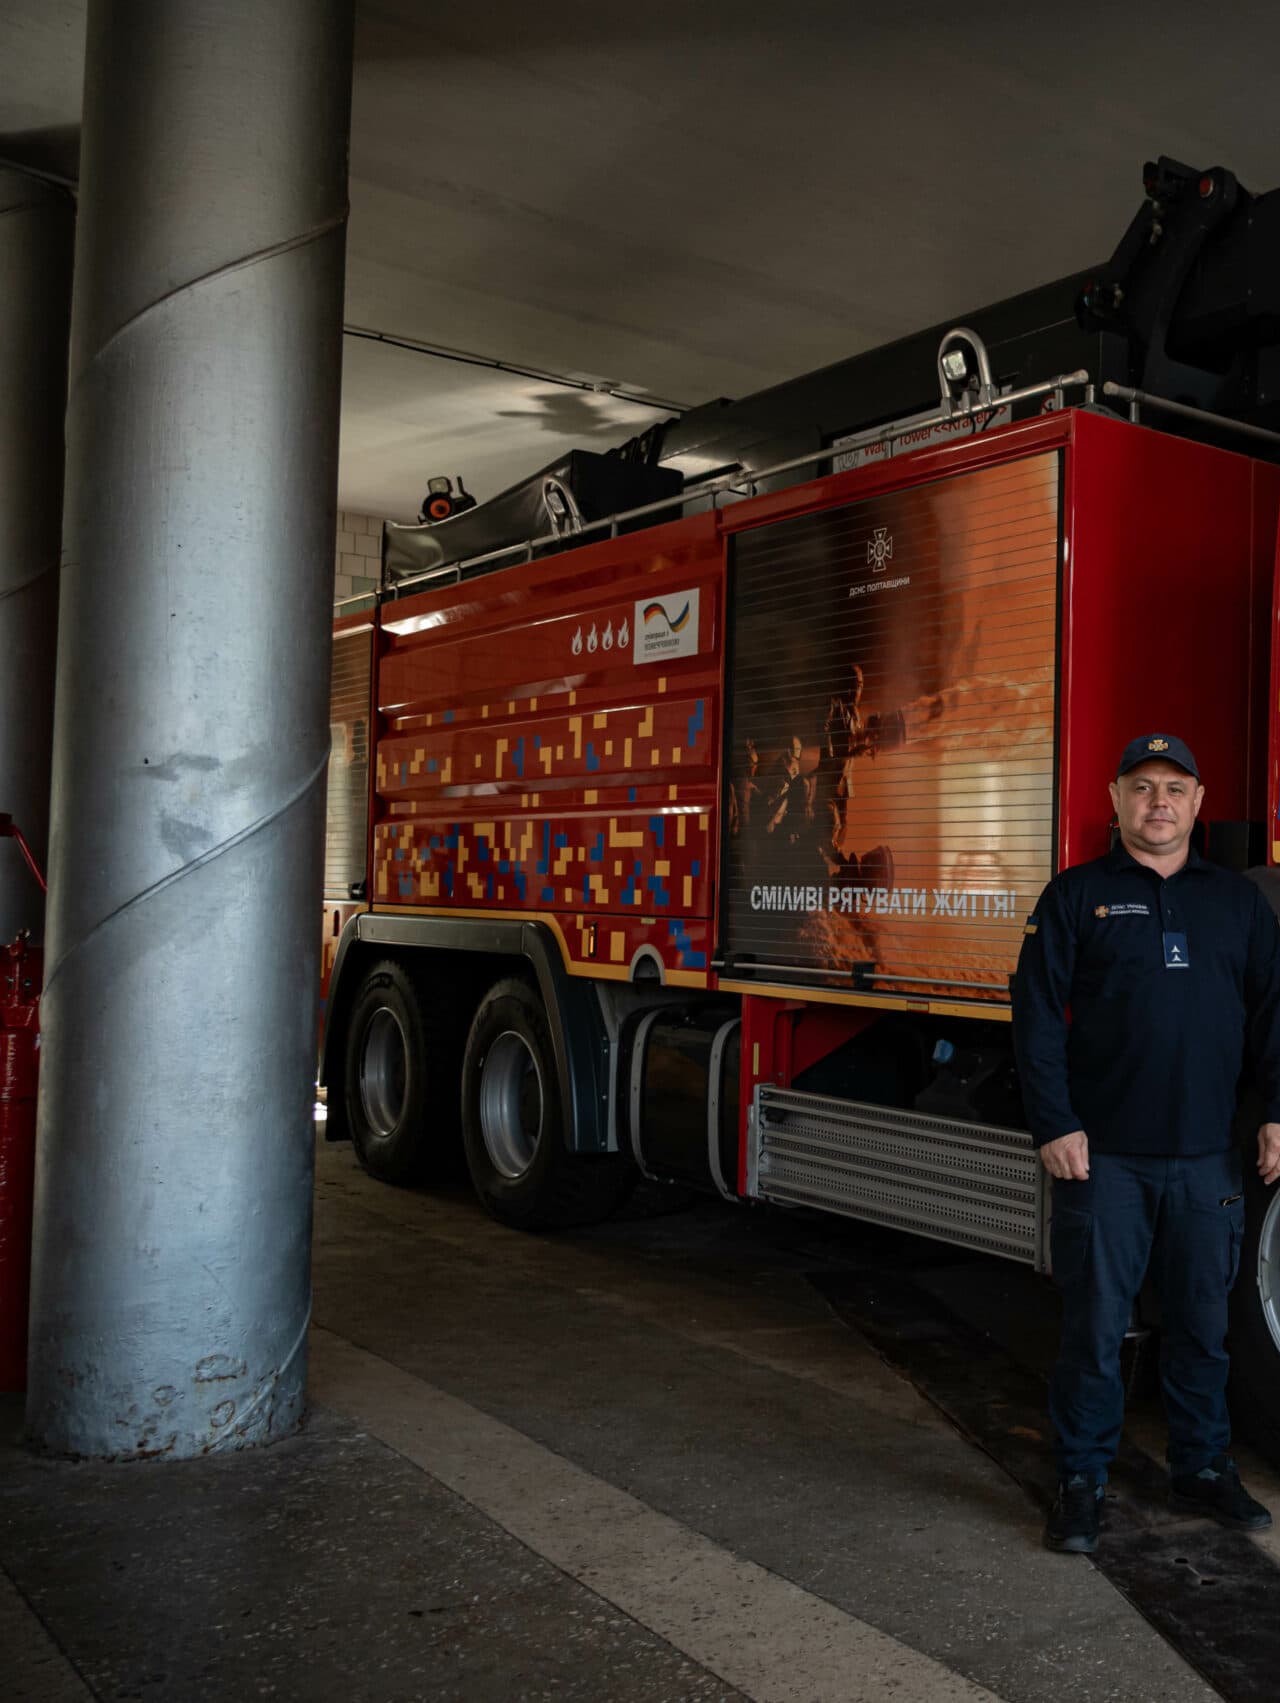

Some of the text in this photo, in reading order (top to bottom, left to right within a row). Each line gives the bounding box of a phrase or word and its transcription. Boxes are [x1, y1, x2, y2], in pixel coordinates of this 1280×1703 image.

[751, 885, 1017, 918] СМІЛИВІ РЯТУВАТИ ЖИТТЯ!
